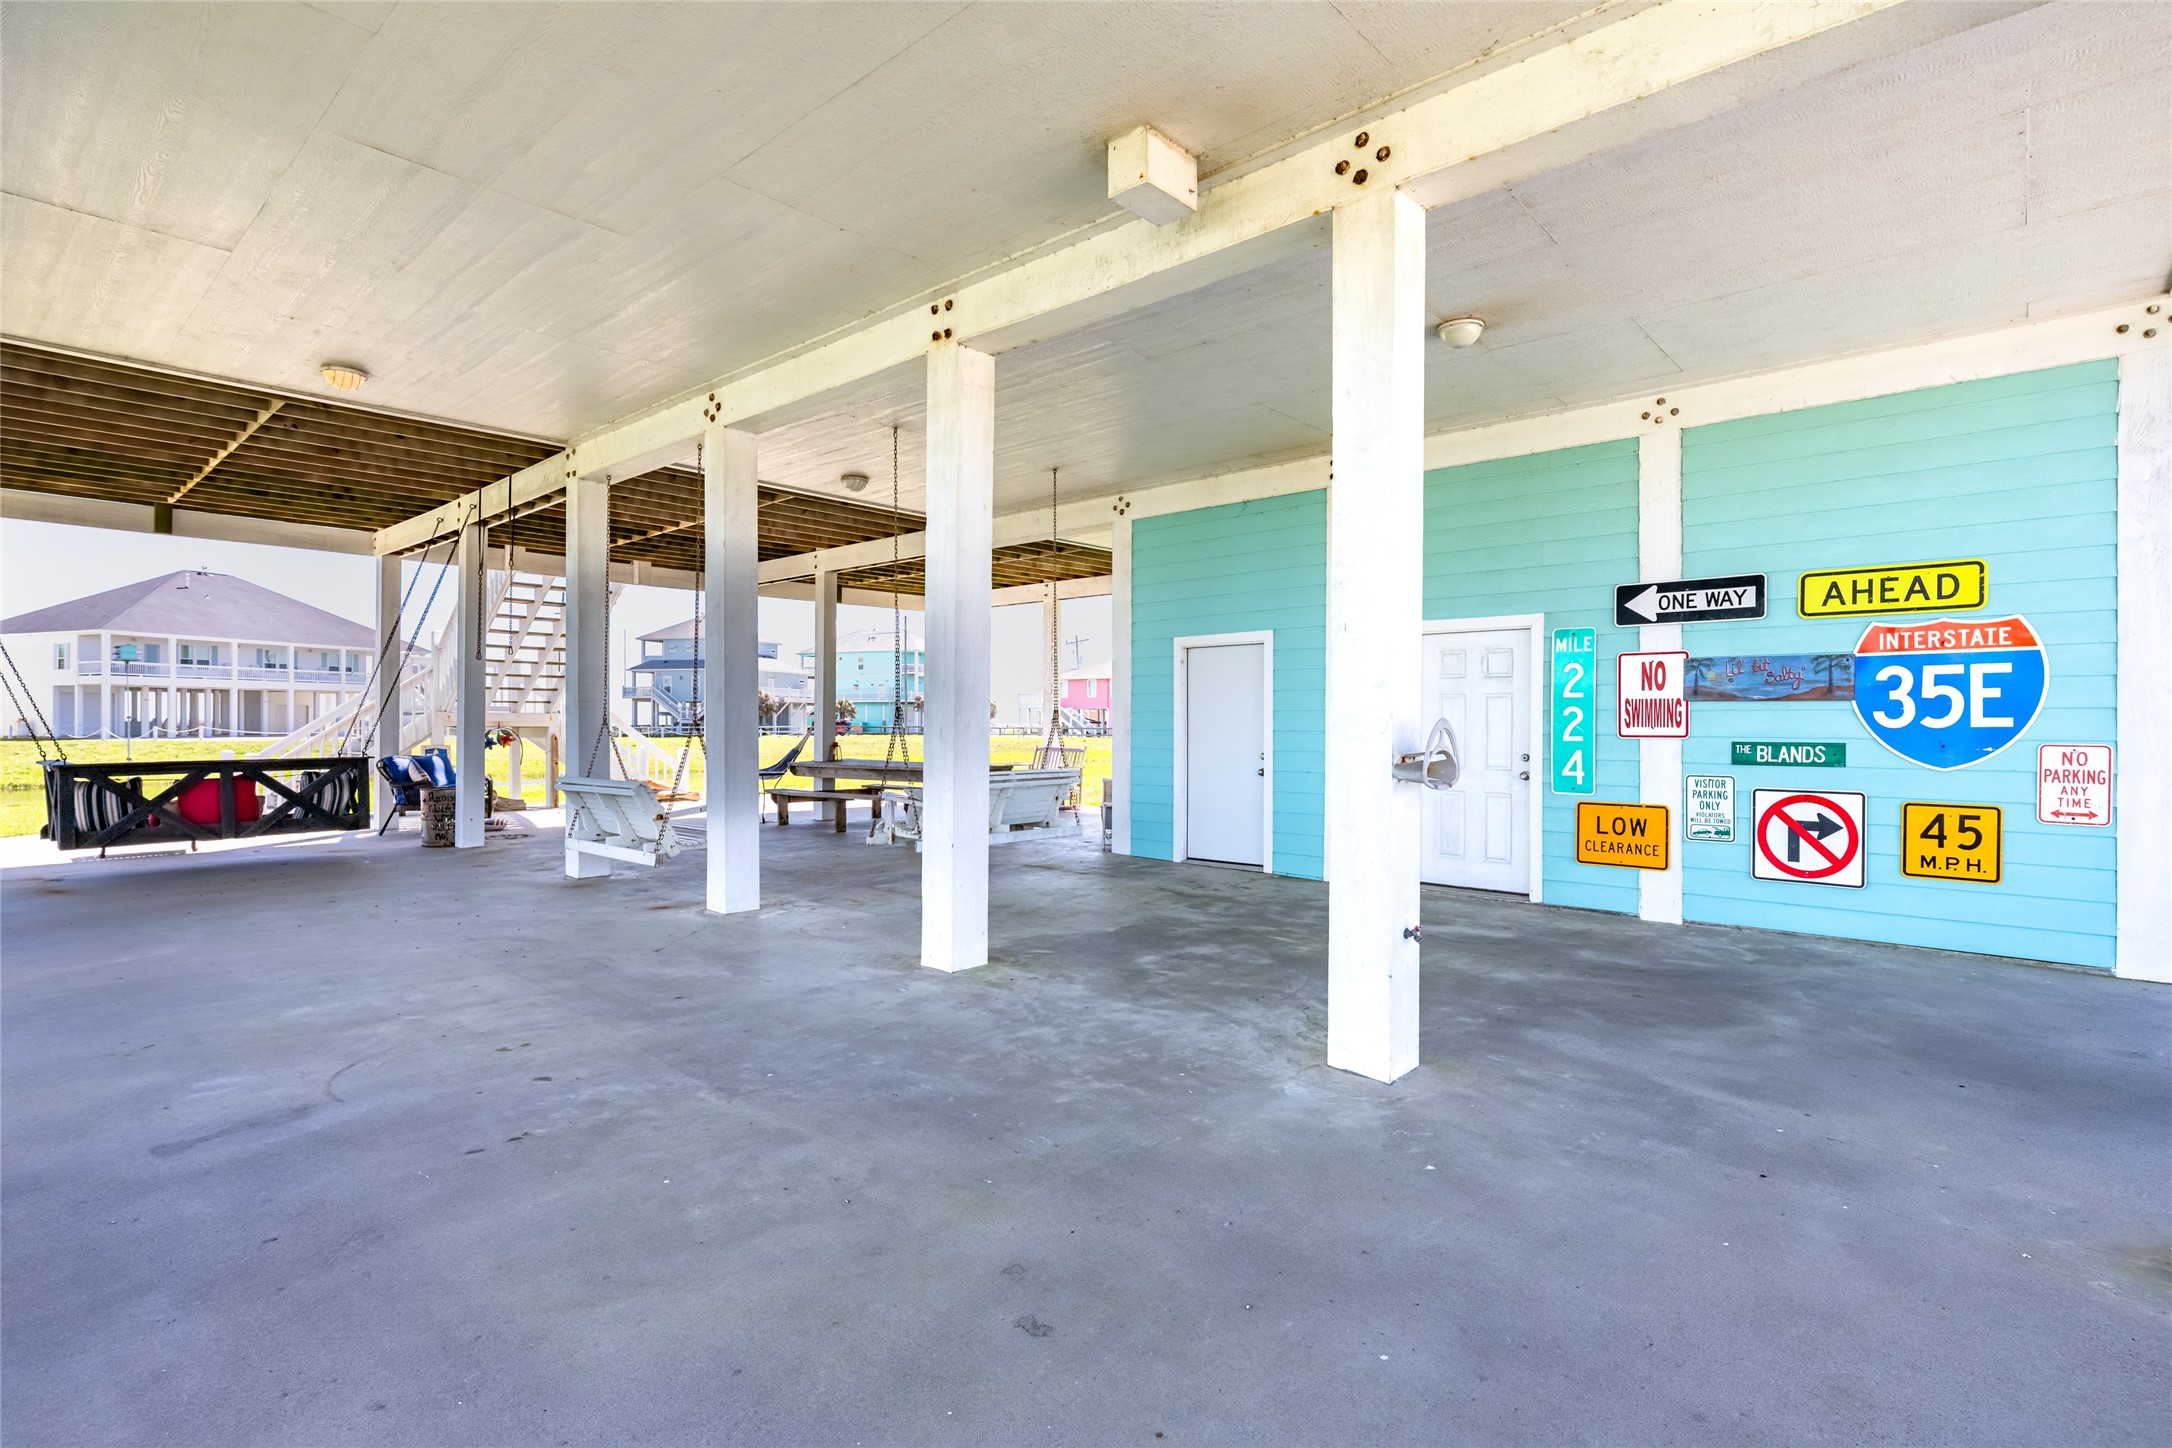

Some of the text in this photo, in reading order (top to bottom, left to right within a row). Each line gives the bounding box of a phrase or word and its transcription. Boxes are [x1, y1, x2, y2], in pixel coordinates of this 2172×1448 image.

[1821, 573, 1960, 607] AHEAD
[1658, 588, 1748, 611] ONE WAY
[1555, 635, 1593, 653] MILE
[1879, 626, 2012, 650] INTERSTATE
[1641, 661, 1667, 691] NO
[1872, 662, 2014, 729] 35E
[1624, 698, 1683, 729] SWIMMING
[1735, 745, 1826, 763] THE BLANDS
[2061, 751, 2088, 766] NO
[1694, 779, 1726, 789] VISITOR
[2044, 769, 2106, 785] PARKING
[1692, 790, 1728, 800] PARKING
[2060, 785, 2088, 796] ANY
[1699, 800, 1720, 811] ONLY
[2057, 797, 2091, 809] TIME
[1695, 811, 1725, 819] VIOLATORS
[1596, 816, 1648, 837] LOW
[1919, 813, 1983, 851] 45
[1585, 839, 1659, 857] CLEARANCE
